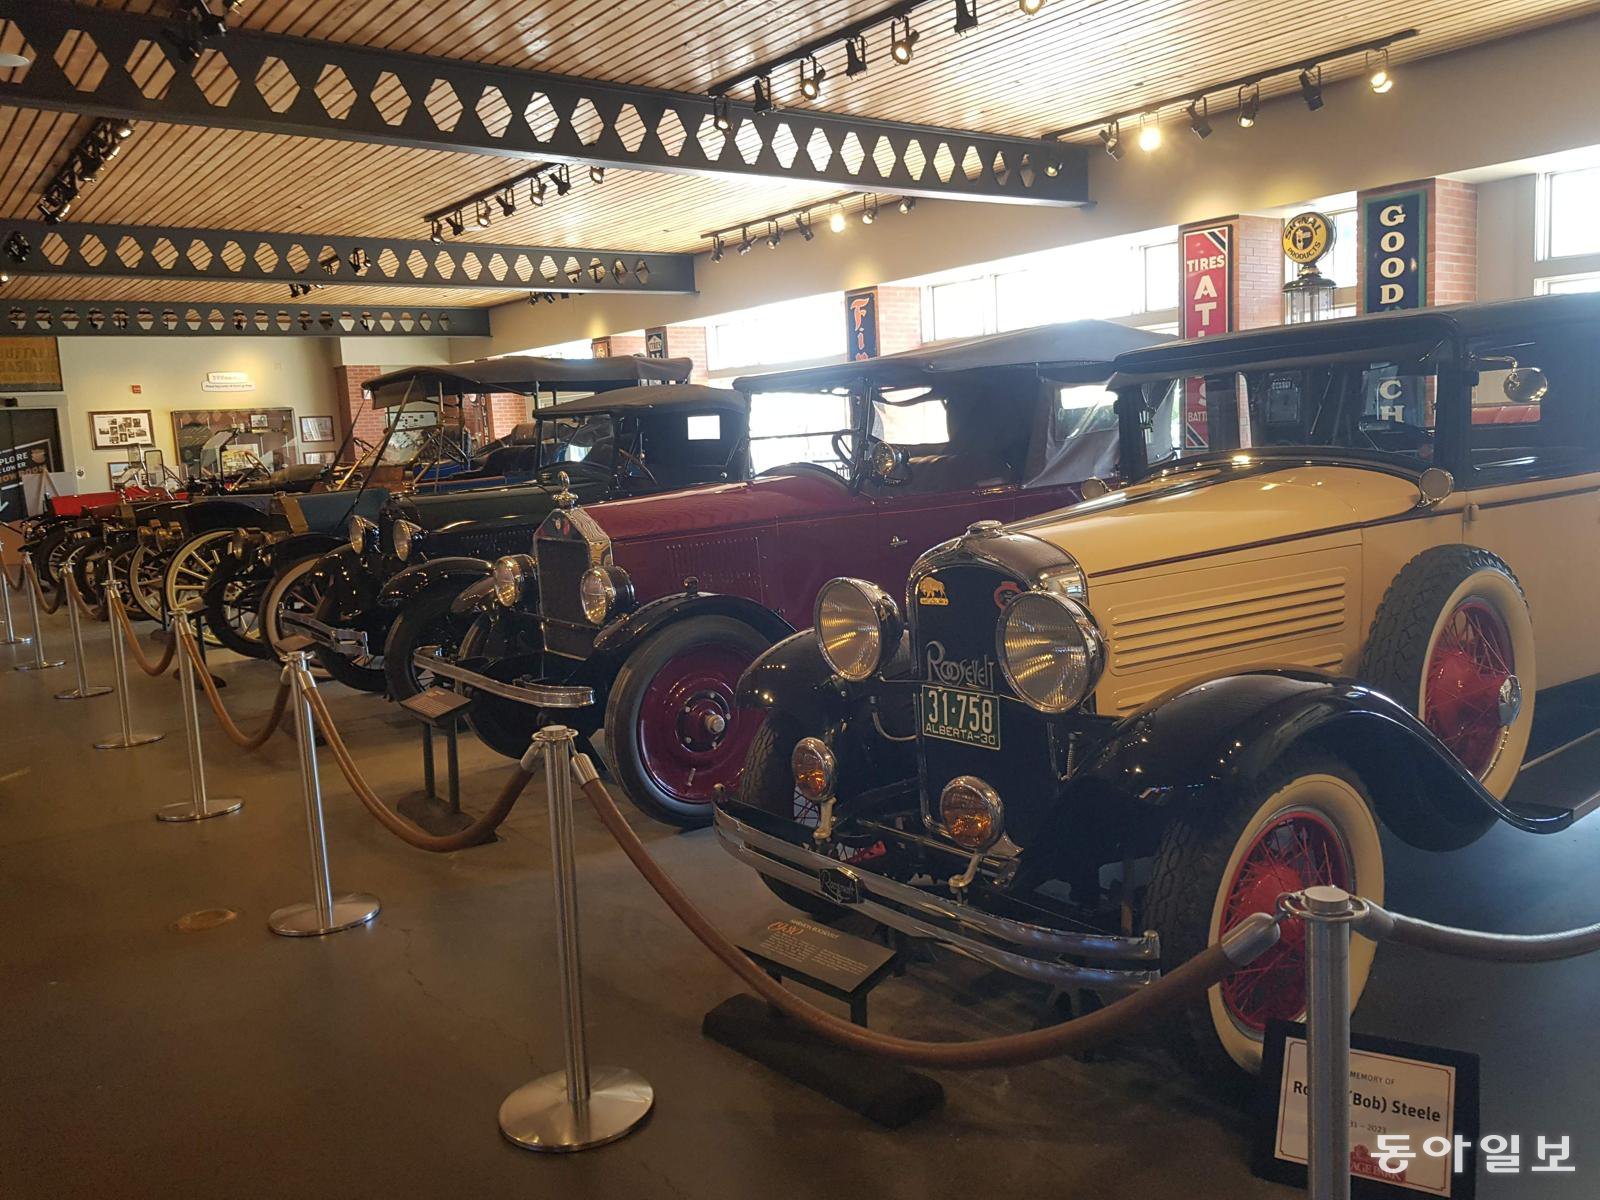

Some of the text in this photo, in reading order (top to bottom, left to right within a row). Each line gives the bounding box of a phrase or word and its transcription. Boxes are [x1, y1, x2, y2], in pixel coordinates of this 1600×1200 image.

[1285, 216, 1321, 240] SIGNAL
[1287, 240, 1321, 259] PRODUCTS
[1187, 255, 1225, 272] TIRES
[1188, 410, 1208, 422] BATT
[1350, 1070, 1383, 1083] MEMORY
[1392, 1100, 1441, 1122] Steele
